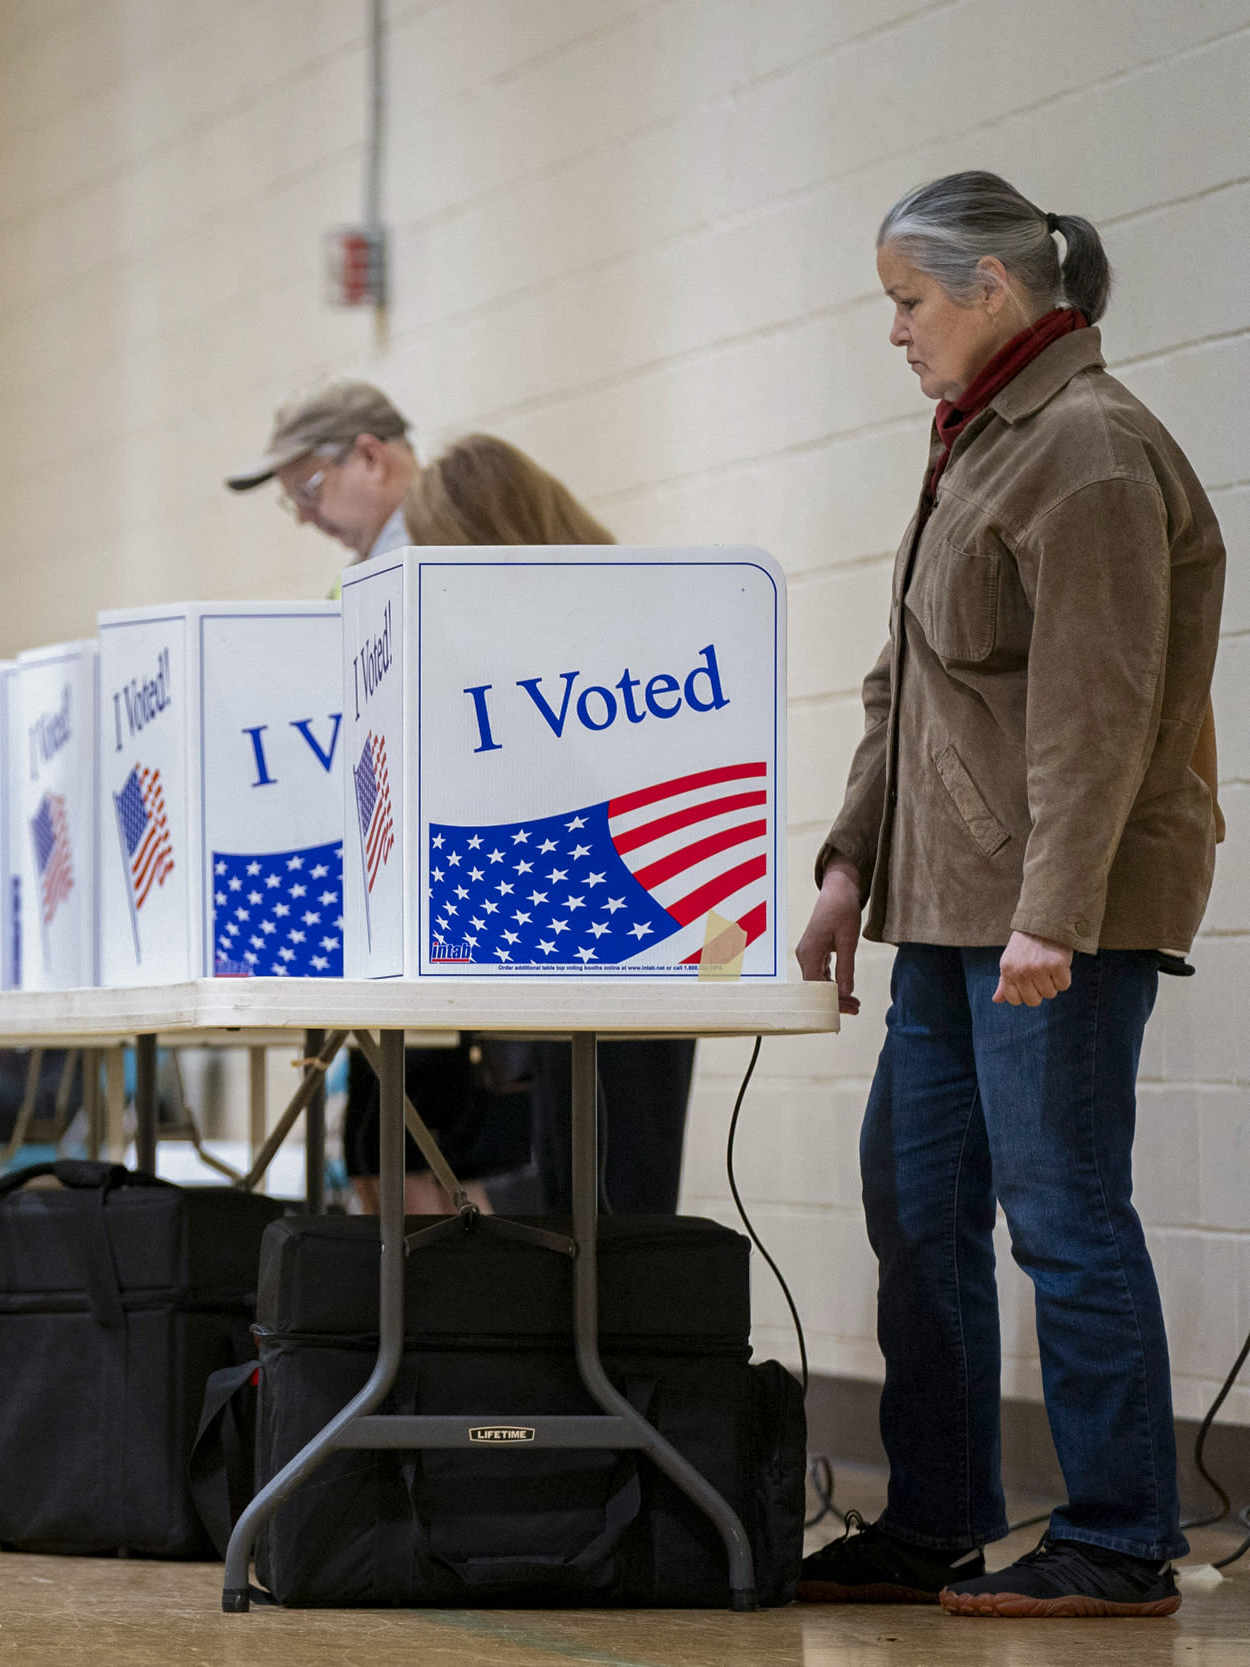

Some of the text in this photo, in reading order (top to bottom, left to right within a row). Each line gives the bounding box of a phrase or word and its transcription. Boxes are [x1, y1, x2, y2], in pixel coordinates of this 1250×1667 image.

[353, 599, 392, 721] I Voted!
[462, 643, 731, 753] I Voted
[242, 725, 278, 788] I
[431, 941, 472, 959] intab
[477, 1430, 527, 1439] LIFETIME
